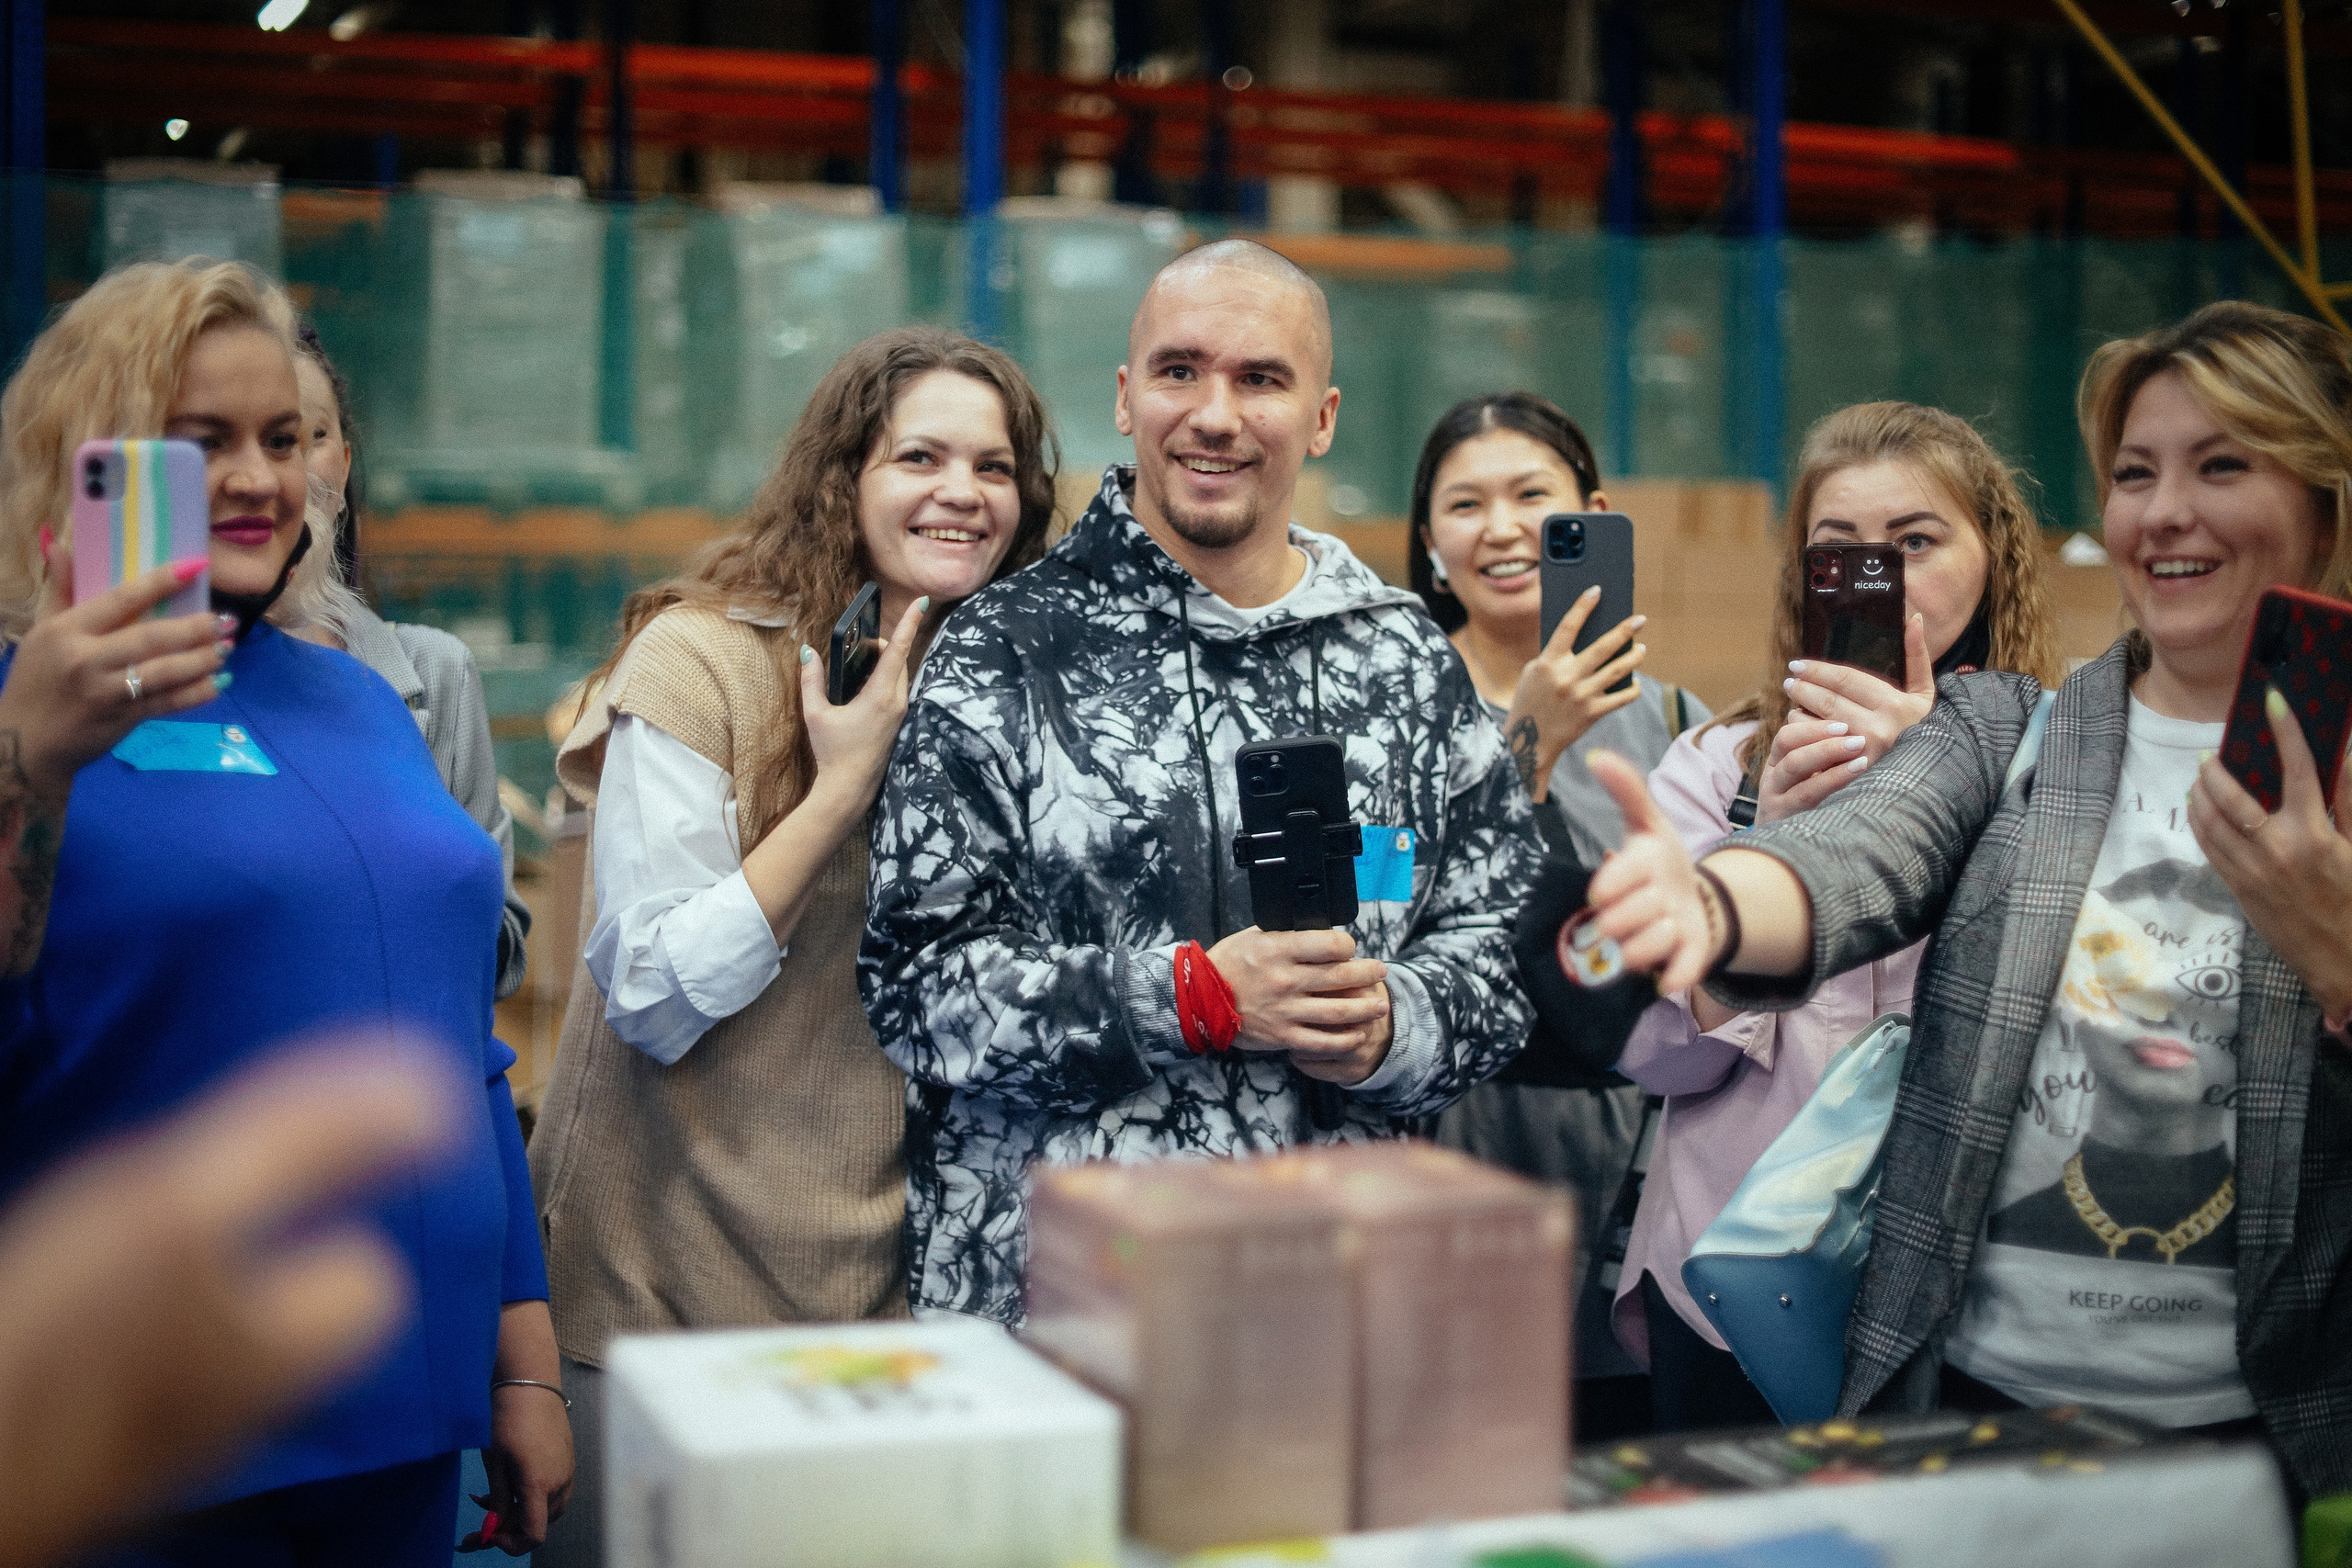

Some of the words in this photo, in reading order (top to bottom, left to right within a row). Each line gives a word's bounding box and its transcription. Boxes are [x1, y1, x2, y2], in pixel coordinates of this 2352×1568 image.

[1854, 580, 1892, 592] niceday
[2020, 1070, 2098, 1126] you
[2069, 1290, 2123, 1310] KEEP
[2130, 1295, 2203, 1312] GOING
